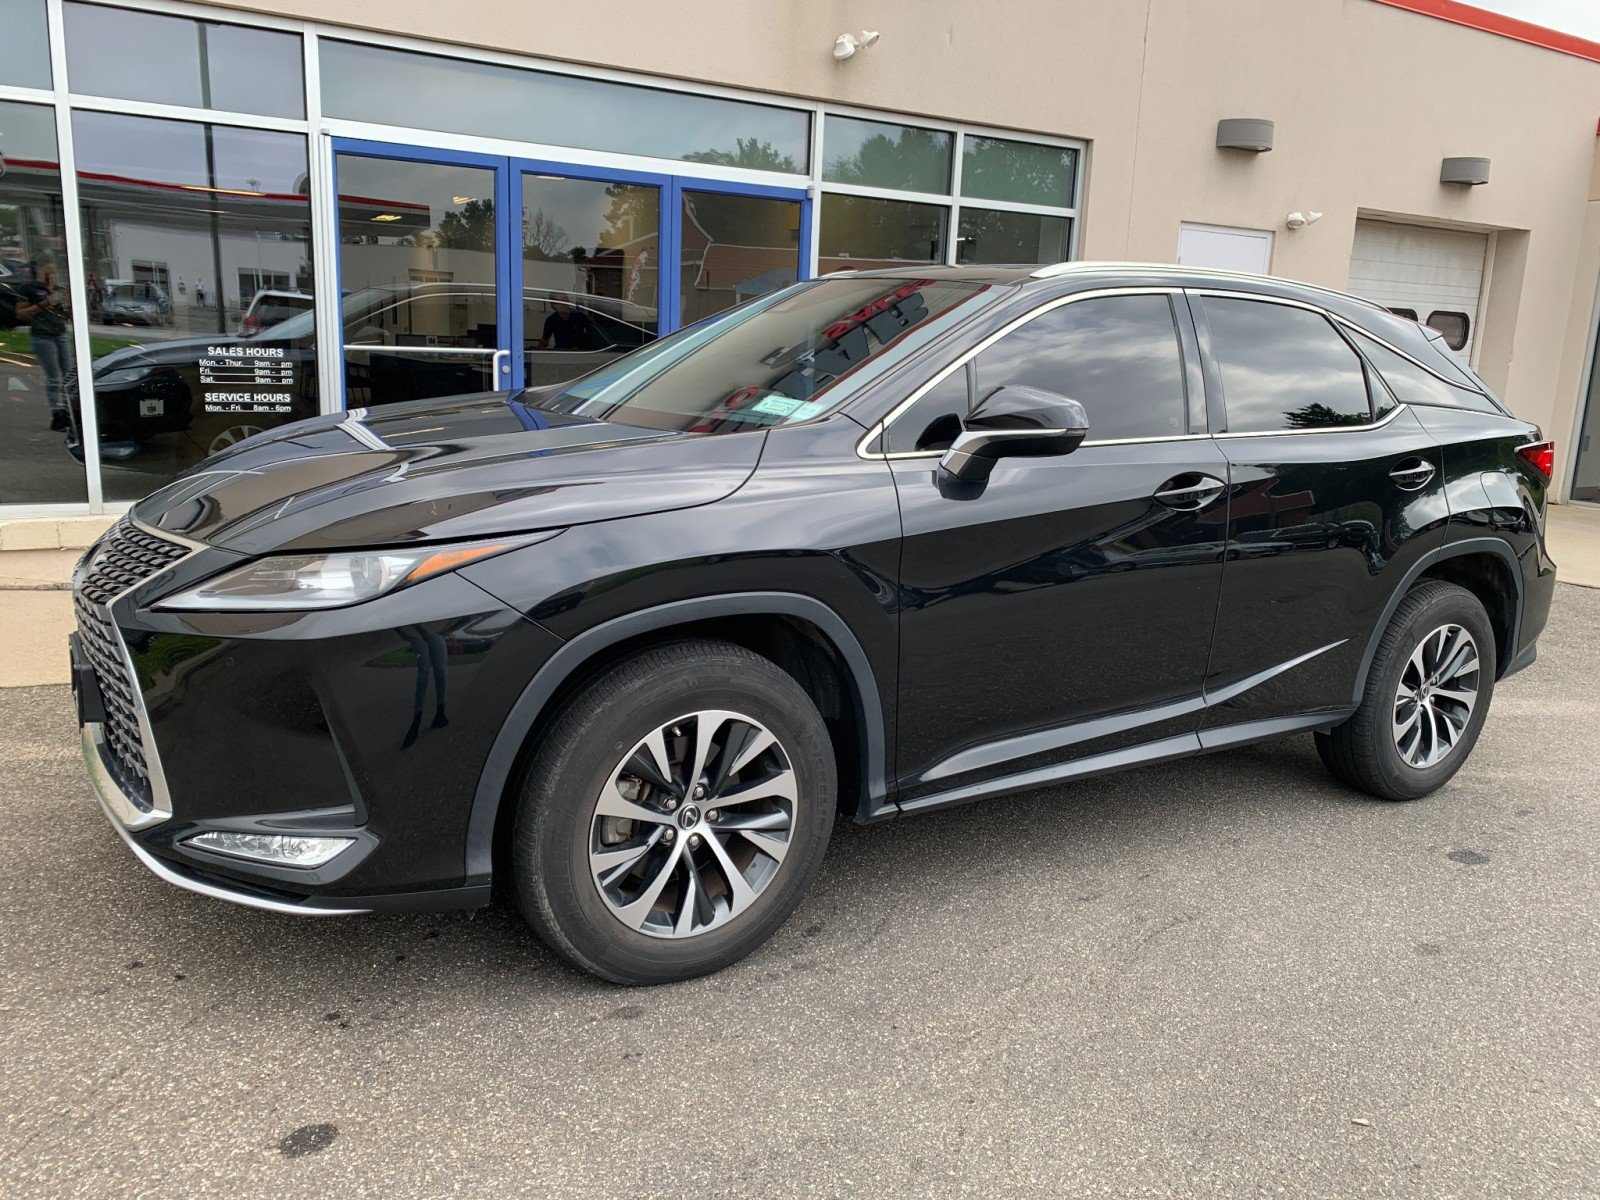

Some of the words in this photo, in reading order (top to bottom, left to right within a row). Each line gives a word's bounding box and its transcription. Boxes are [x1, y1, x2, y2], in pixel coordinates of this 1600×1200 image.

[208, 346, 243, 356] SALES
[246, 348, 284, 357] HOURS
[254, 368, 271, 376] 9am
[205, 393, 251, 402] SERVICE
[254, 394, 290, 403] HOURS
